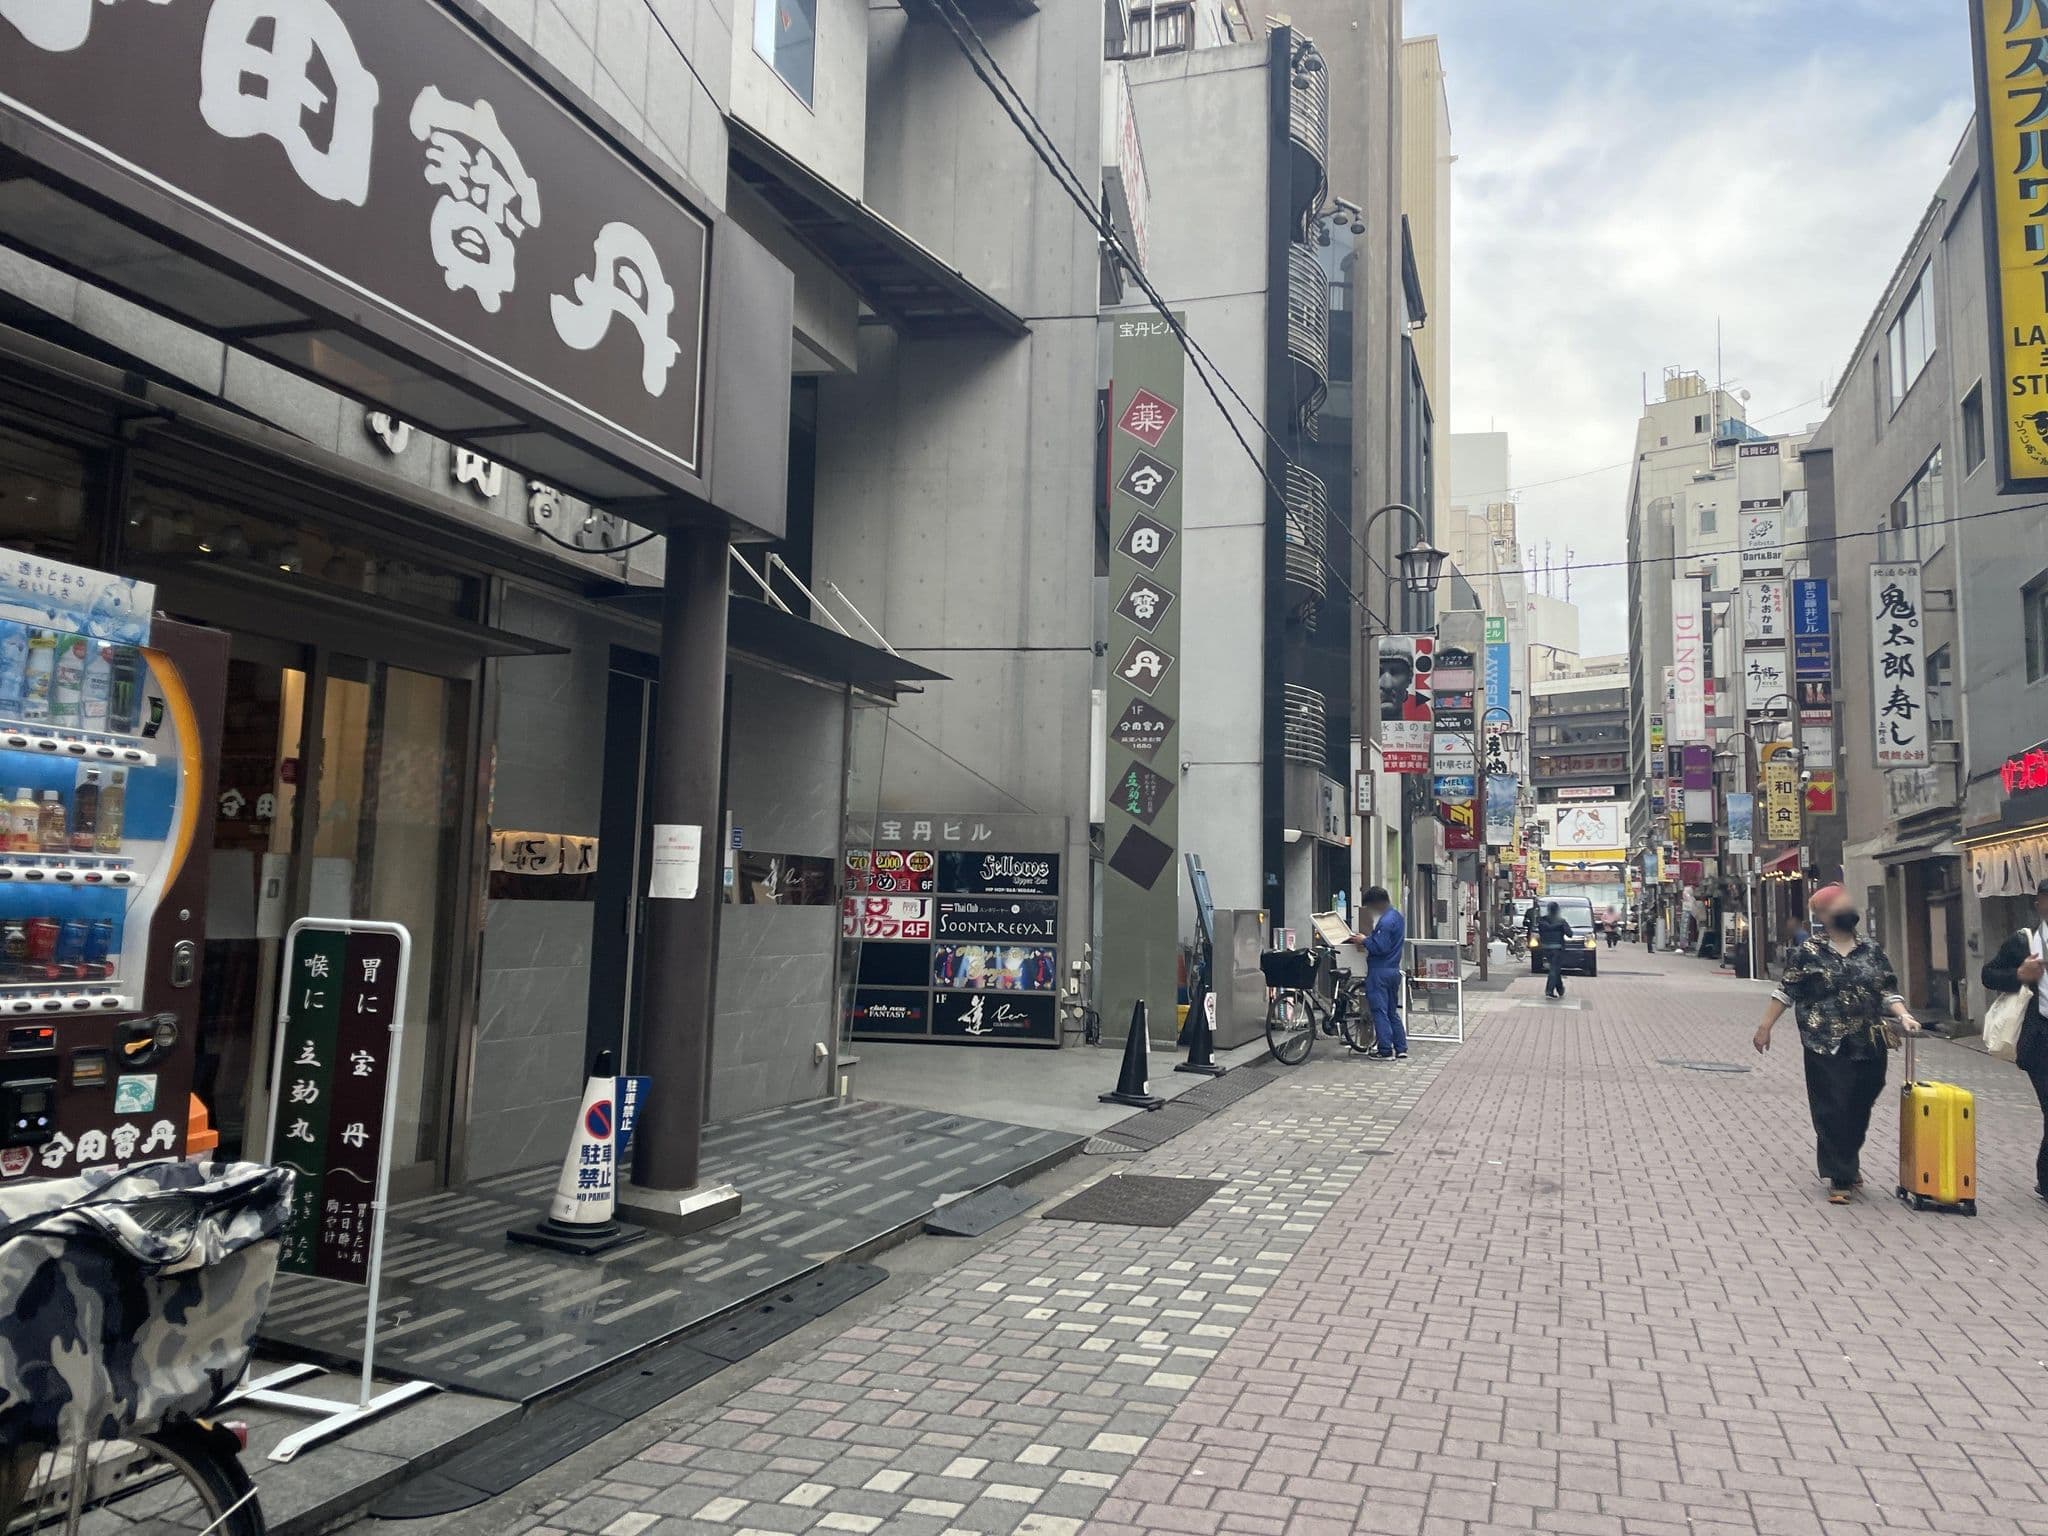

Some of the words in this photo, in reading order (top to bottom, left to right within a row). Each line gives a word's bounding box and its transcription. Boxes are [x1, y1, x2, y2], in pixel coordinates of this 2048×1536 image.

[1131, 402, 1164, 432] 薬
[19, 560, 85, 588] 透きとおる
[19, 578, 72, 600] おいしさ
[881, 821, 992, 842] 宝丹ビル
[921, 880, 933, 890] 6F
[903, 922, 927, 936] 4F
[357, 957, 382, 1014] 胃に
[935, 993, 948, 1003] 1F
[869, 1010, 907, 1018] FANTASY
[620, 1079, 638, 1131] 駐車禁止
[579, 1144, 612, 1165] 駐車
[578, 1167, 611, 1189] 禁止
[576, 1192, 587, 1202] NO
